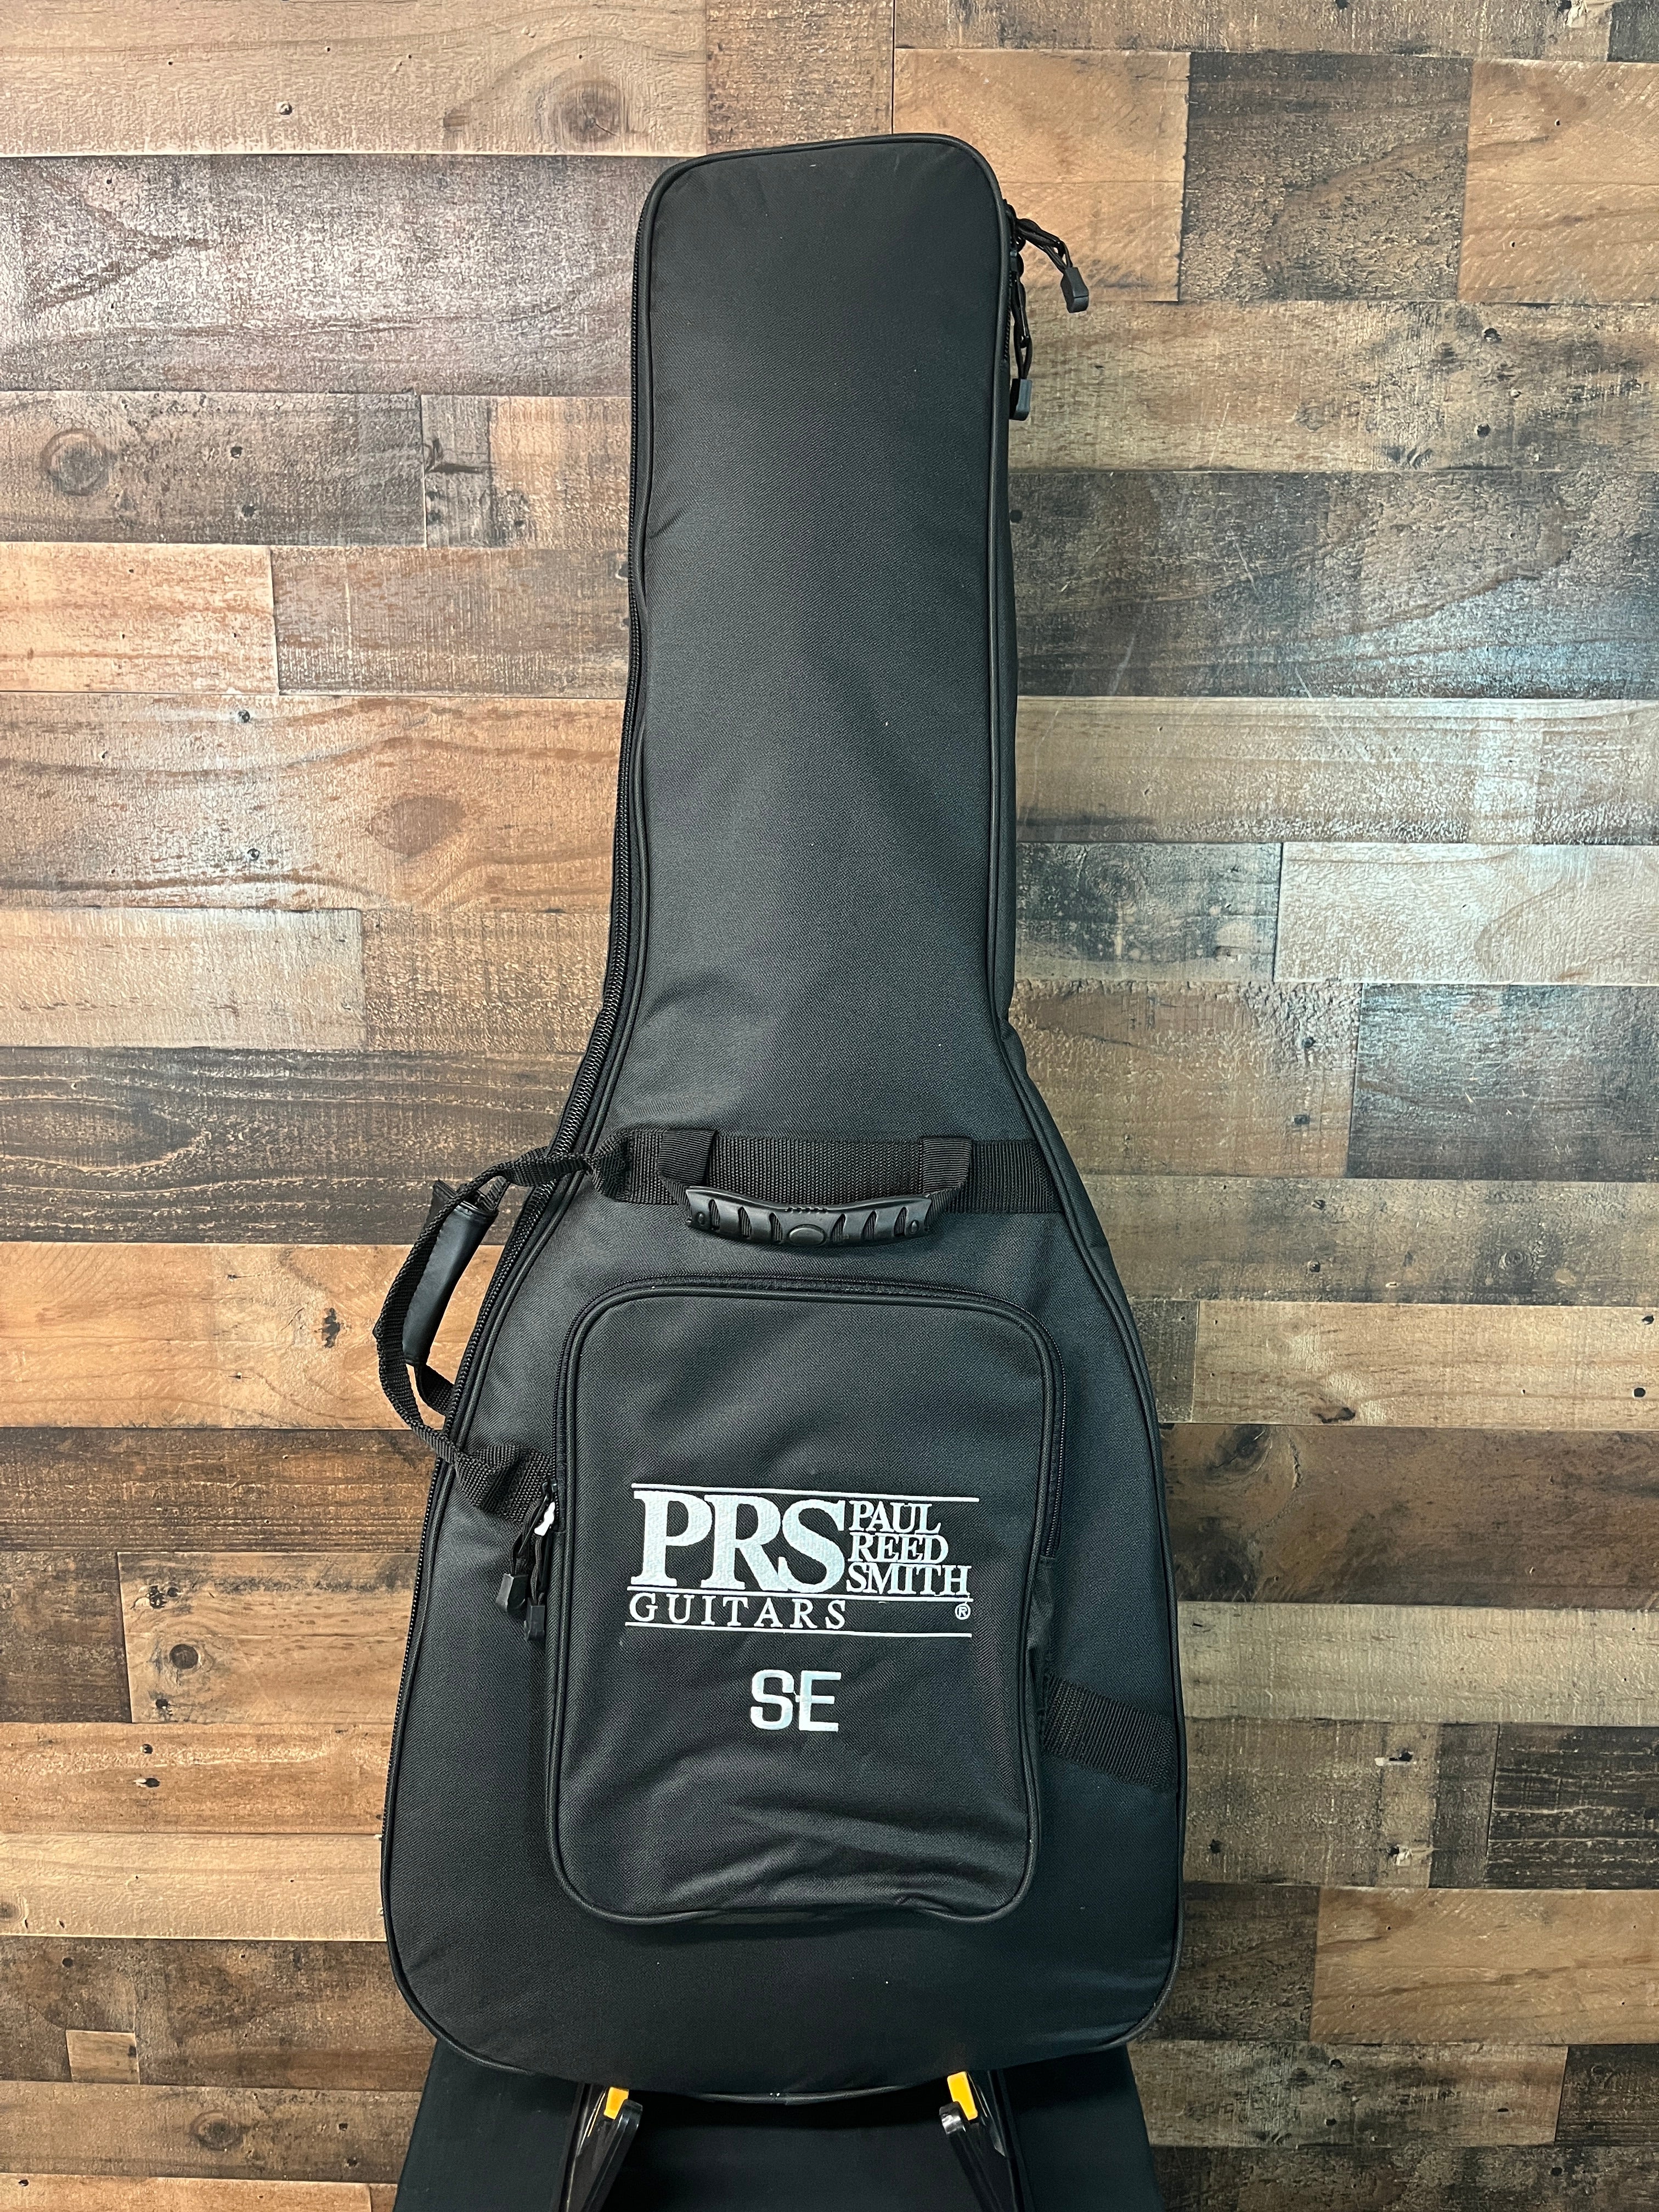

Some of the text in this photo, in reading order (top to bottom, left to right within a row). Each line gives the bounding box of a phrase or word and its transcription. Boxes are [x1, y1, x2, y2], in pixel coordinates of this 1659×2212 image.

[849, 1500, 941, 1534] PAUL
[630, 1490, 846, 1593] PRS
[847, 1534, 949, 1564] REED
[845, 1562, 972, 1596] SMITH
[629, 1593, 846, 1630] GUITARS
[750, 1669, 842, 1733] SE
